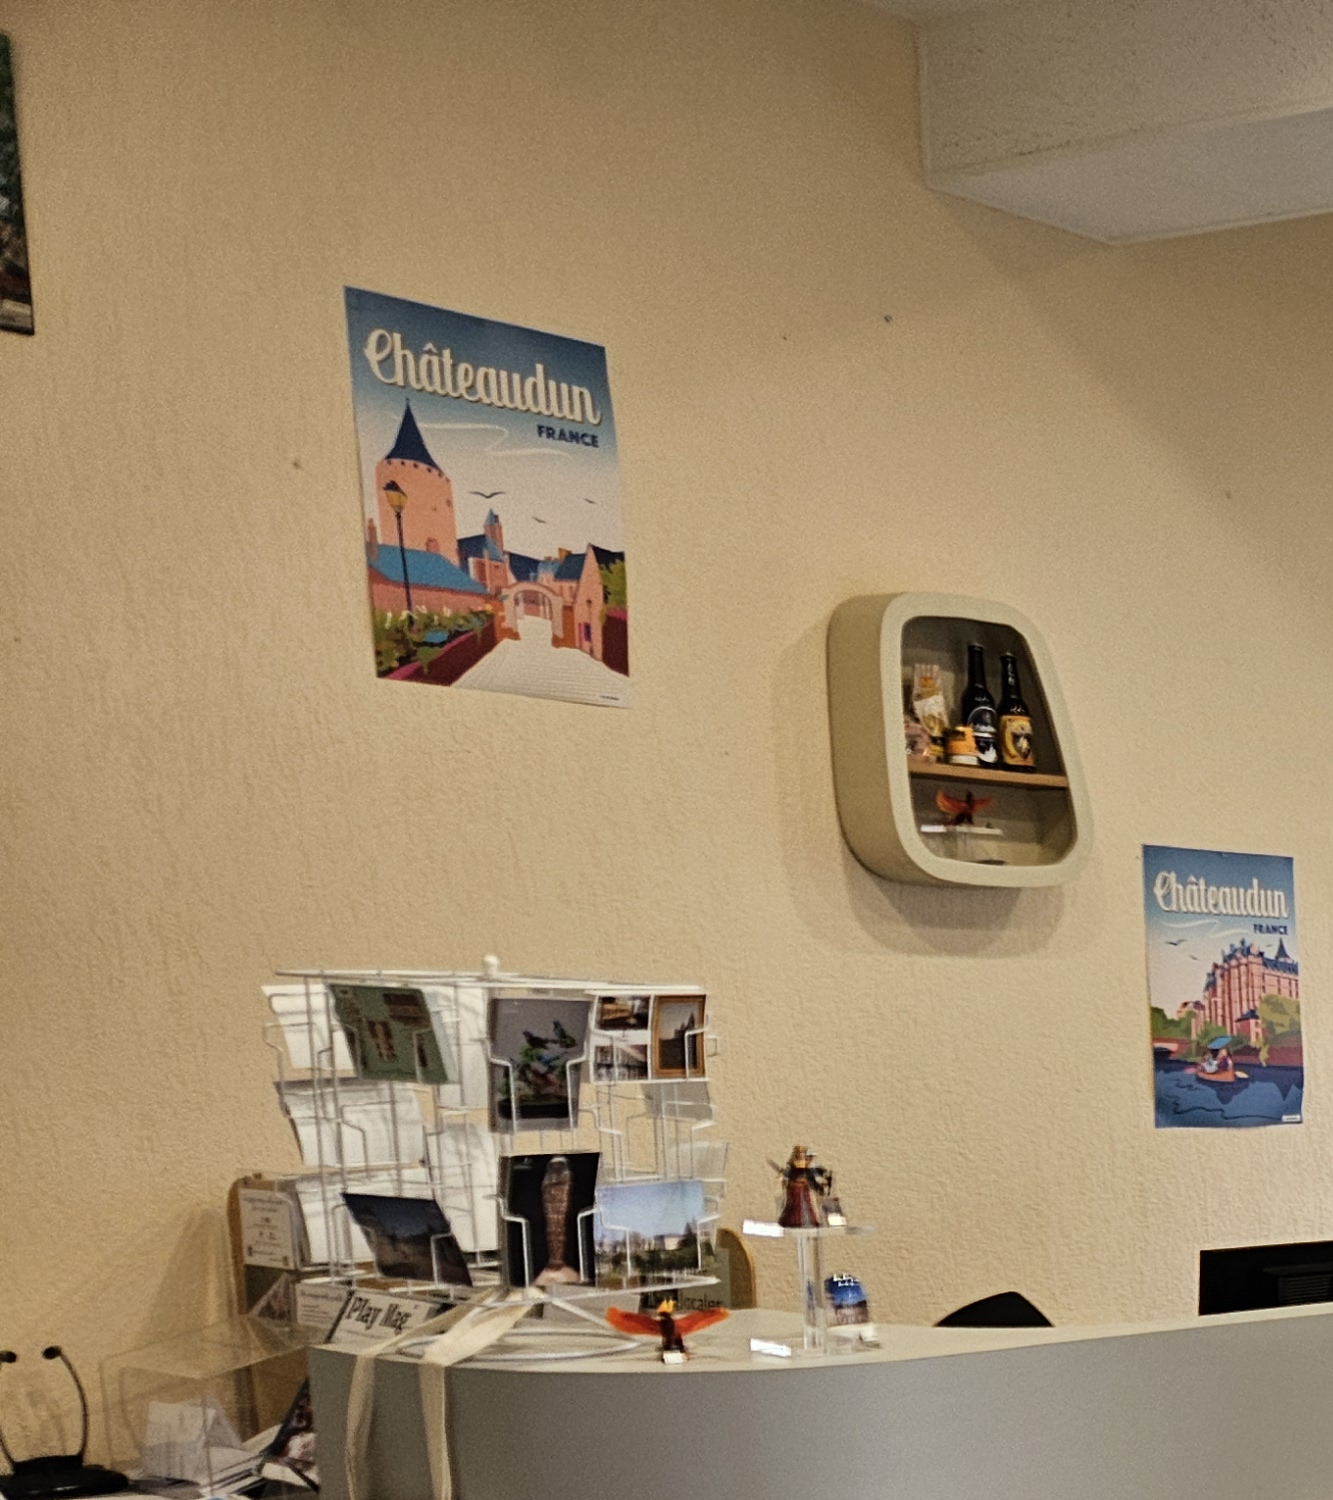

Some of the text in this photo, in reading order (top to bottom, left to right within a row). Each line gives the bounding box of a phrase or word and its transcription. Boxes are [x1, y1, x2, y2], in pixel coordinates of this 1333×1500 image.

[364, 328, 602, 426] Châteaudun
[536, 424, 600, 448] FRANCE
[1153, 870, 1290, 919] Châteaudun
[1253, 923, 1289, 936] FRANCE
[348, 1296, 383, 1331] Play
